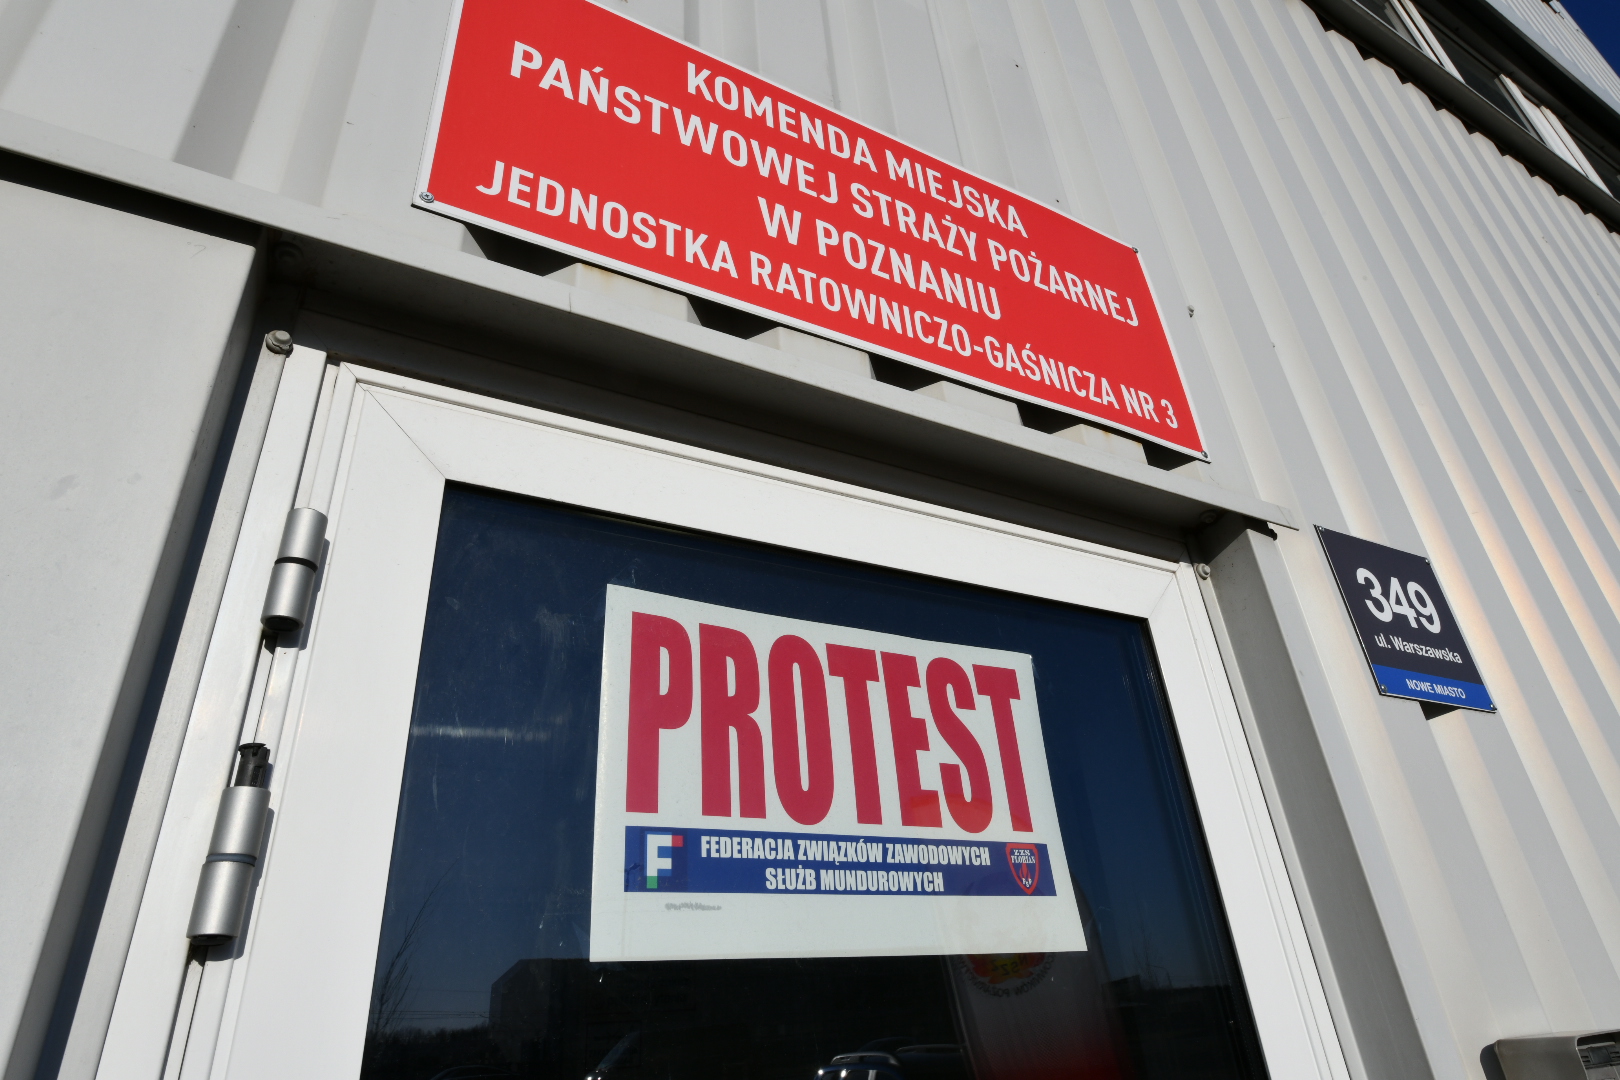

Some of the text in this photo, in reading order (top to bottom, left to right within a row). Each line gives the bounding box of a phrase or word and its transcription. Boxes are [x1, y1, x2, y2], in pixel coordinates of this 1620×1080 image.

[510, 40, 1139, 328] PAŃSTWOWEJ STRAŻY POŻARNEJ
[686, 61, 1029, 238] KOMENDA MIEJSKA
[475, 160, 1179, 429] JEDNOSTKA RATOWNICZO-GAŚNICZA NR 3
[757, 195, 1001, 320] W POZNANIU
[1356, 567, 1441, 634] 349
[1374, 632, 1462, 664] ul. Warszawska
[625, 610, 1034, 834] PROTEST
[1405, 678, 1466, 699] NOWE MIASTO
[700, 835, 991, 866] FEDERACJA ZWIĄZKÓW ZAWODOWYCH
[765, 865, 945, 892] SŁUŻB MUNDUROWYCH
